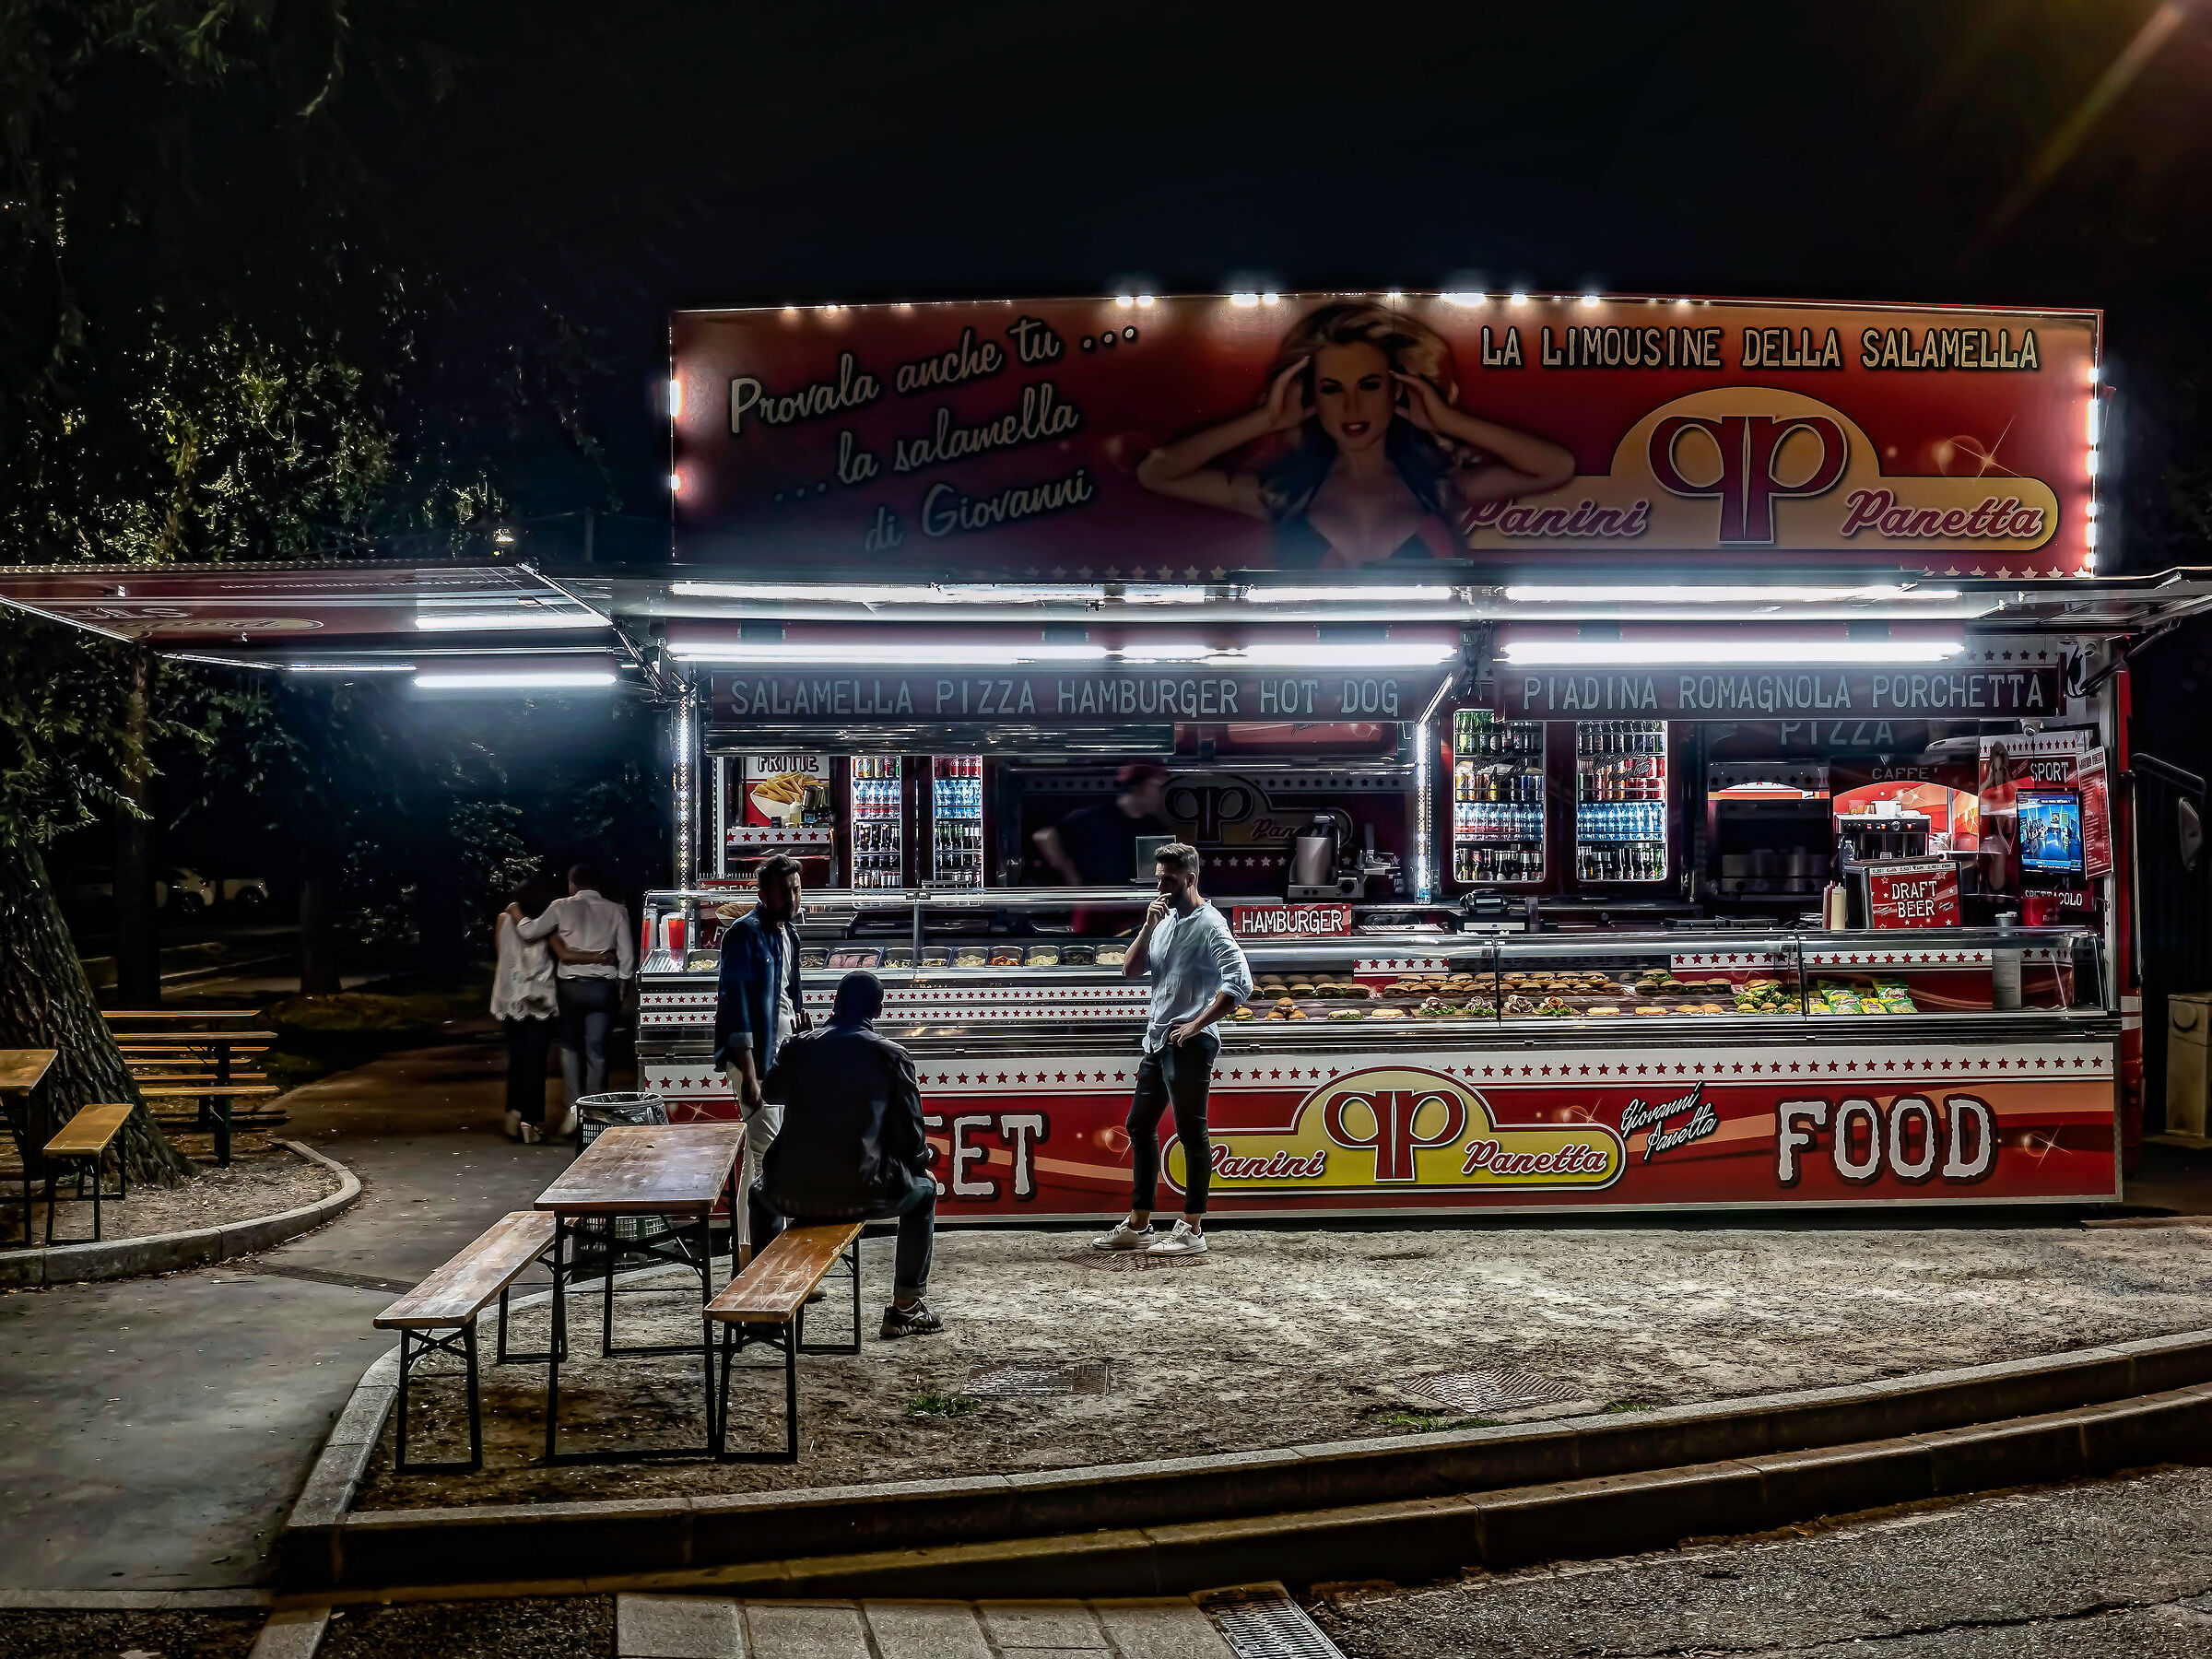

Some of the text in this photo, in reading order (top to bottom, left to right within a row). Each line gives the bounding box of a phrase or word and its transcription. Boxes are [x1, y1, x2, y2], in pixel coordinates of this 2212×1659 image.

[1482, 325, 2040, 370] LA LIMOUSINE DELLA SALAMELLA
[731, 354, 879, 433] Provala
[896, 327, 1003, 394] anche
[1009, 319, 1060, 363] tu
[893, 382, 1078, 471] salamella
[865, 469, 1093, 552] di Giovanni
[1840, 487, 2045, 540] Panetta
[730, 678, 1400, 719] SALAMELLA PIZZA HAMBURGER HOT DOG
[1524, 673, 2044, 713] PIADINA ROMAGNOLA PORCHETTA
[1781, 722, 1895, 746] PIZZA
[2030, 760, 2069, 784] SPORT
[1891, 880, 1937, 900] DRAFT
[1897, 900, 1936, 918] BEER
[1241, 910, 1344, 935] HAMBURGER
[1620, 1080, 1702, 1138] Giovanni
[1643, 1102, 1718, 1160] Panetta
[1777, 1097, 1992, 1182] FOOD
[1209, 1138, 1609, 1179] Panini Panetta
